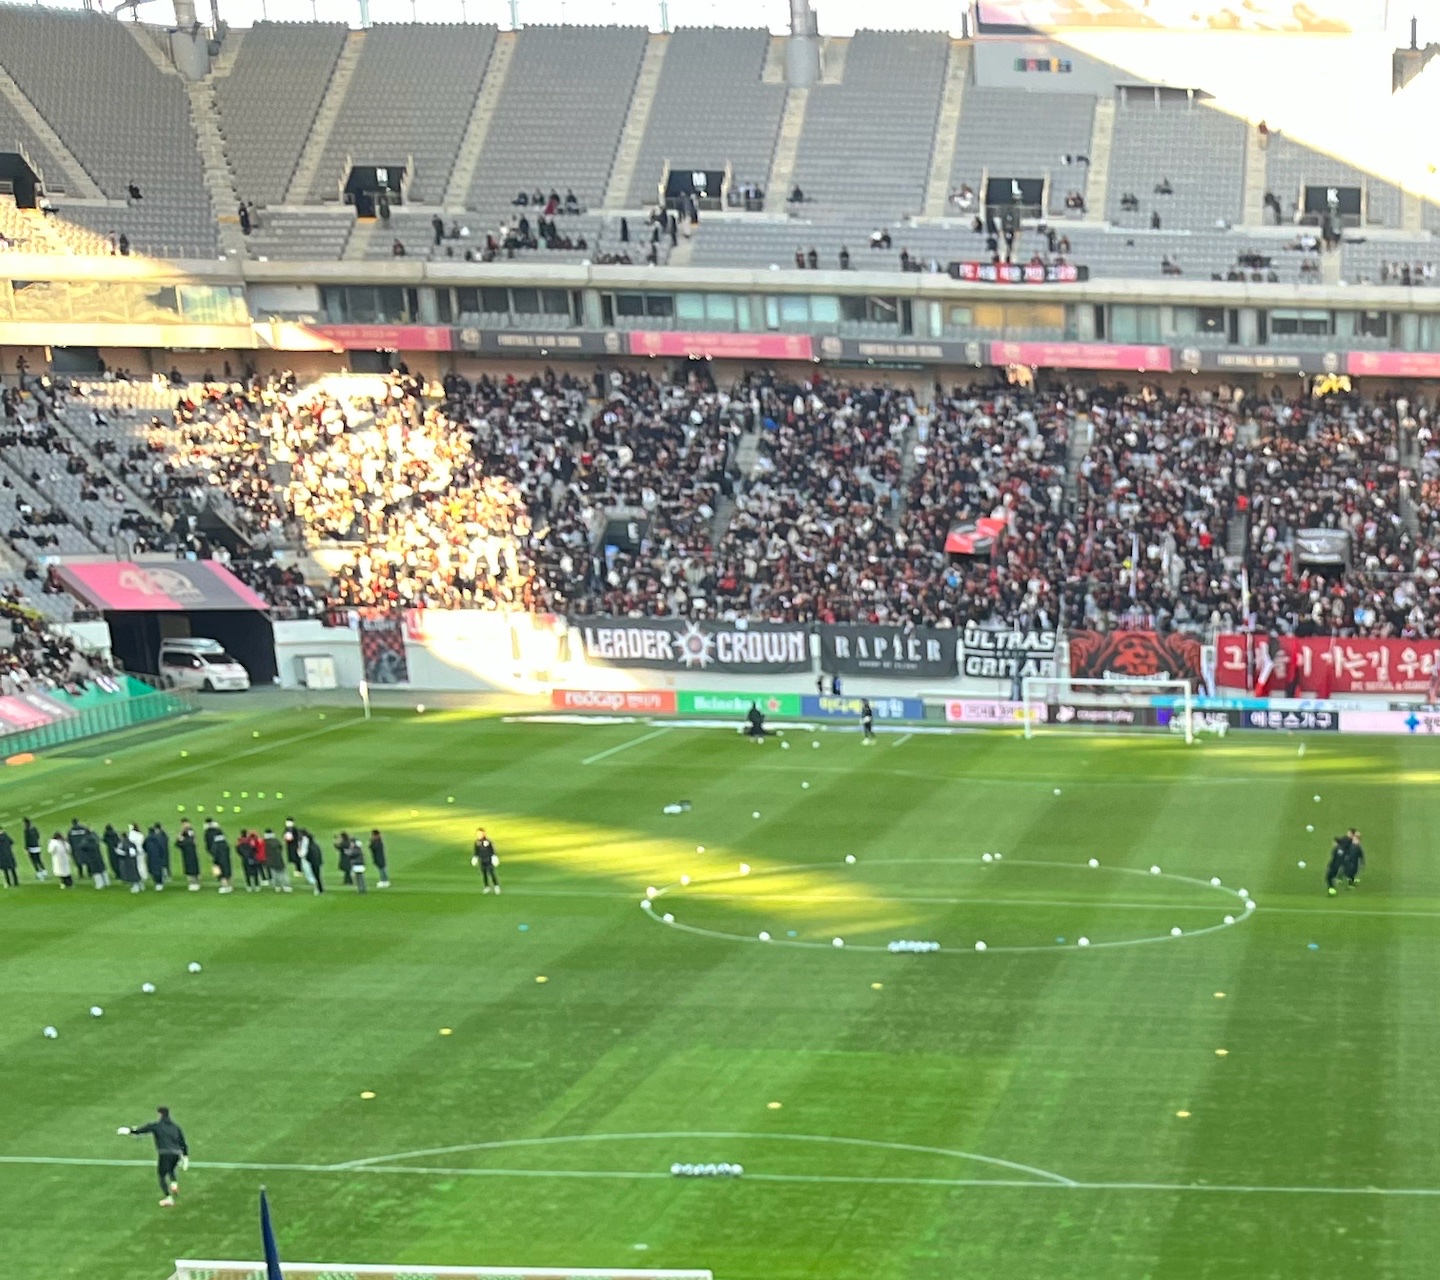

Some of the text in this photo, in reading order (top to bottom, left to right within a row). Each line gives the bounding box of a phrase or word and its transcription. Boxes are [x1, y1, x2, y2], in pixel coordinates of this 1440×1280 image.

[584, 627, 806, 663] LEADER CROWN
[834, 634, 942, 661] RAPIER
[963, 628, 1055, 650] ULTRAS
[1250, 710, 1332, 728] 에몬스가구
